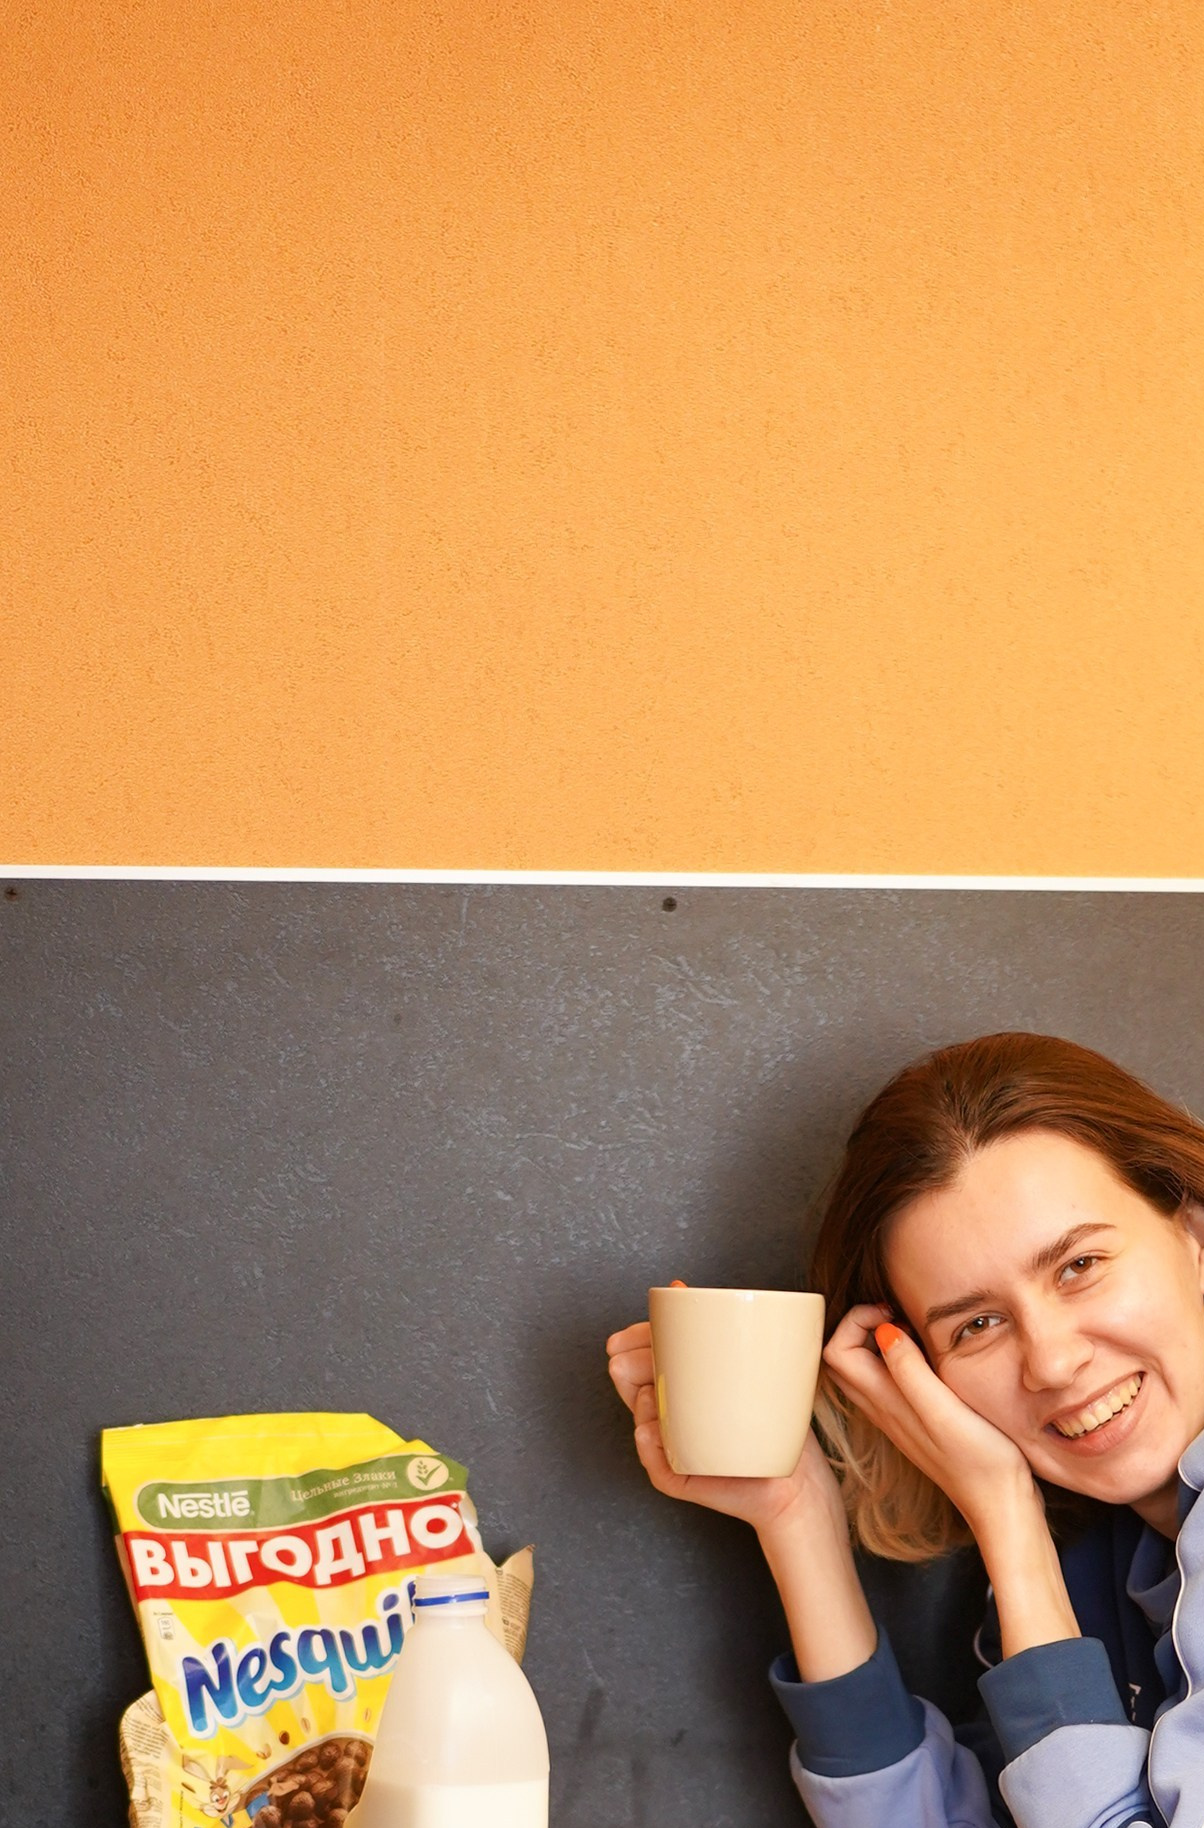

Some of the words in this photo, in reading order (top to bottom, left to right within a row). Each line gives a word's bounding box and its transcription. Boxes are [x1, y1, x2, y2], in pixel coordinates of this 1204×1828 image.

[290, 1476, 350, 1503] Цельные
[352, 1470, 396, 1485] Злаки
[182, 1580, 416, 1732] Nesqui
